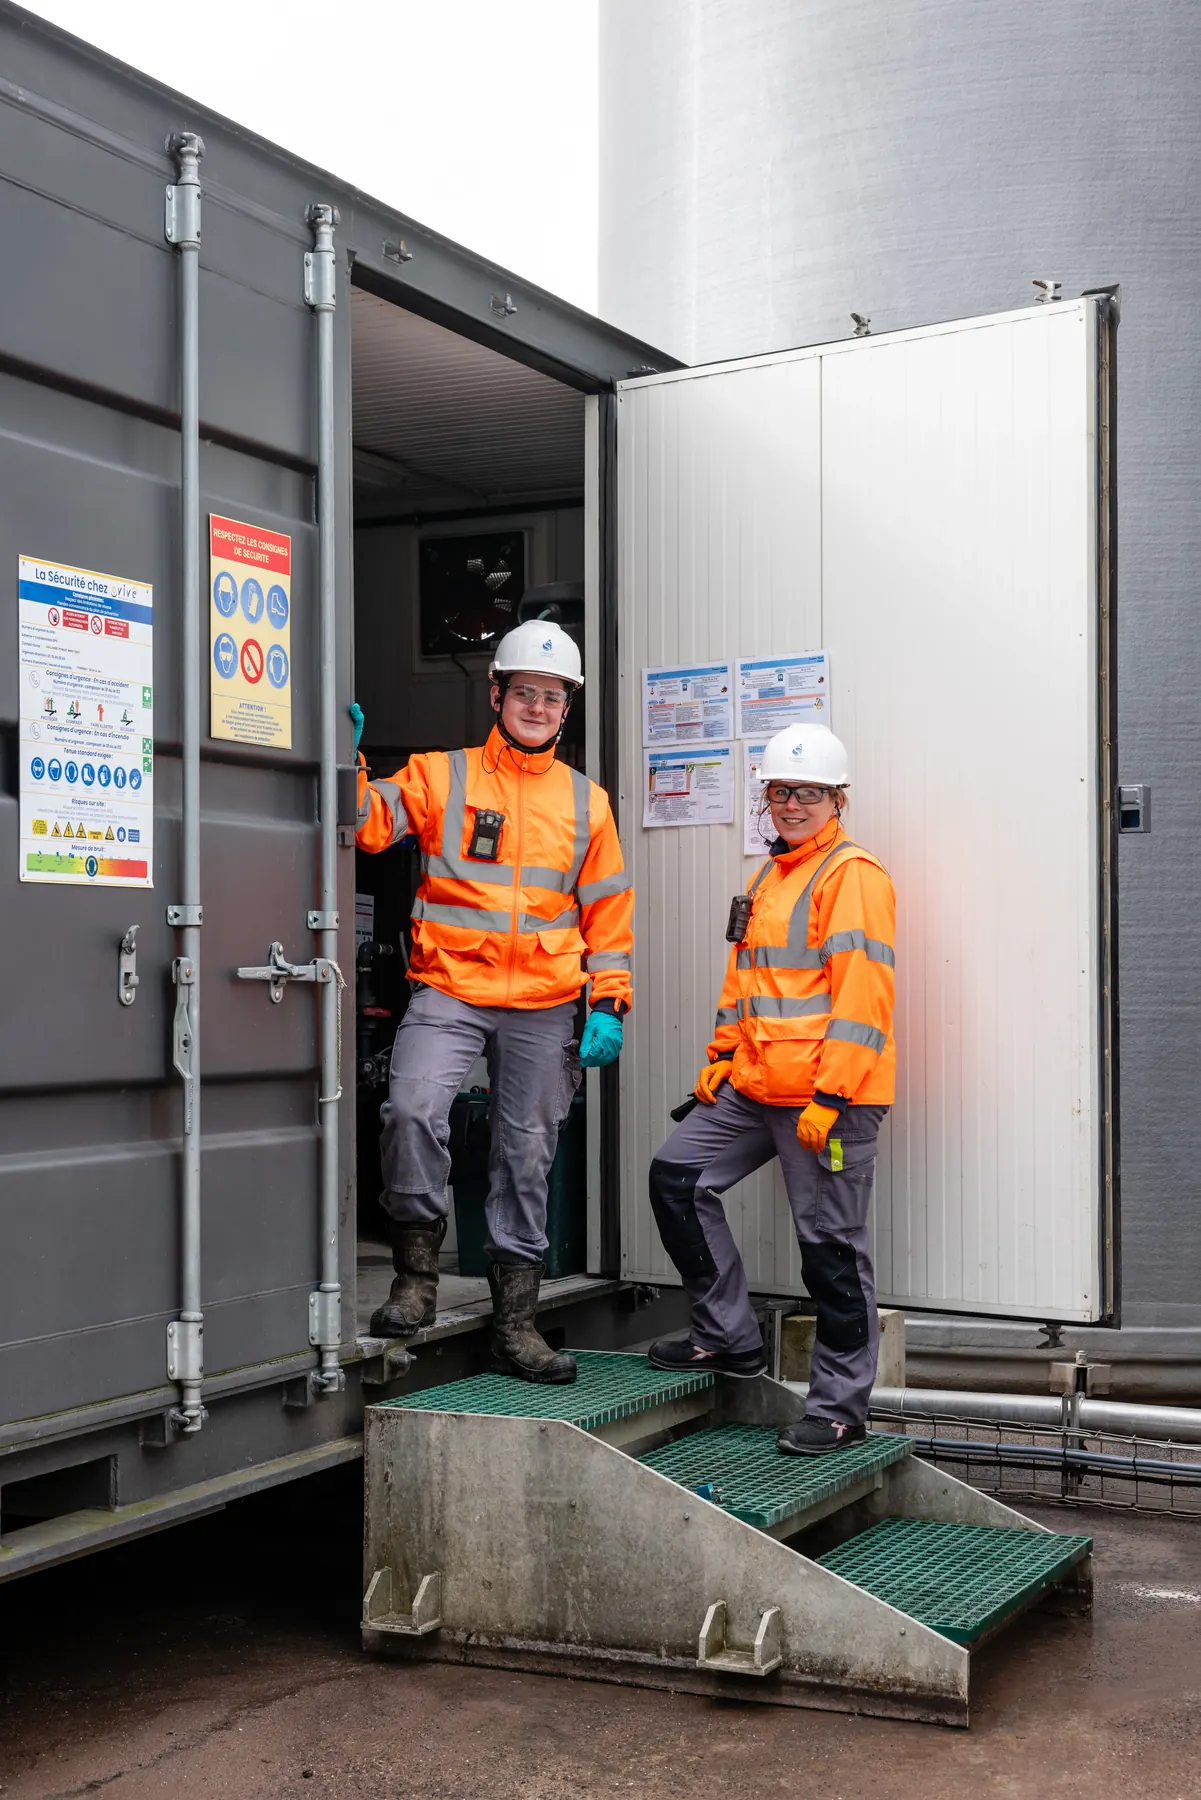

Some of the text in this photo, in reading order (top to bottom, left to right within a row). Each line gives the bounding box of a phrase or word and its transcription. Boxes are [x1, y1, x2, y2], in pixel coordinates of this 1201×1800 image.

[214, 528, 288, 556] RESPECTEZ LES CONSIGNES
[234, 546, 269, 563] DE SECURITE
[36, 568, 46, 579] La
[48, 571, 86, 589] Sécurité
[88, 580, 108, 594] chez
[46, 670, 68, 679] Consignes
[69, 673, 90, 683] d'urgence
[108, 680, 129, 688] d'accident
[239, 703, 263, 712] ATTENTION
[47, 724, 69, 732] Consignes
[70, 727, 91, 735] d'urgence
[108, 732, 129, 740] d'incendie
[72, 798, 88, 806] Risques
